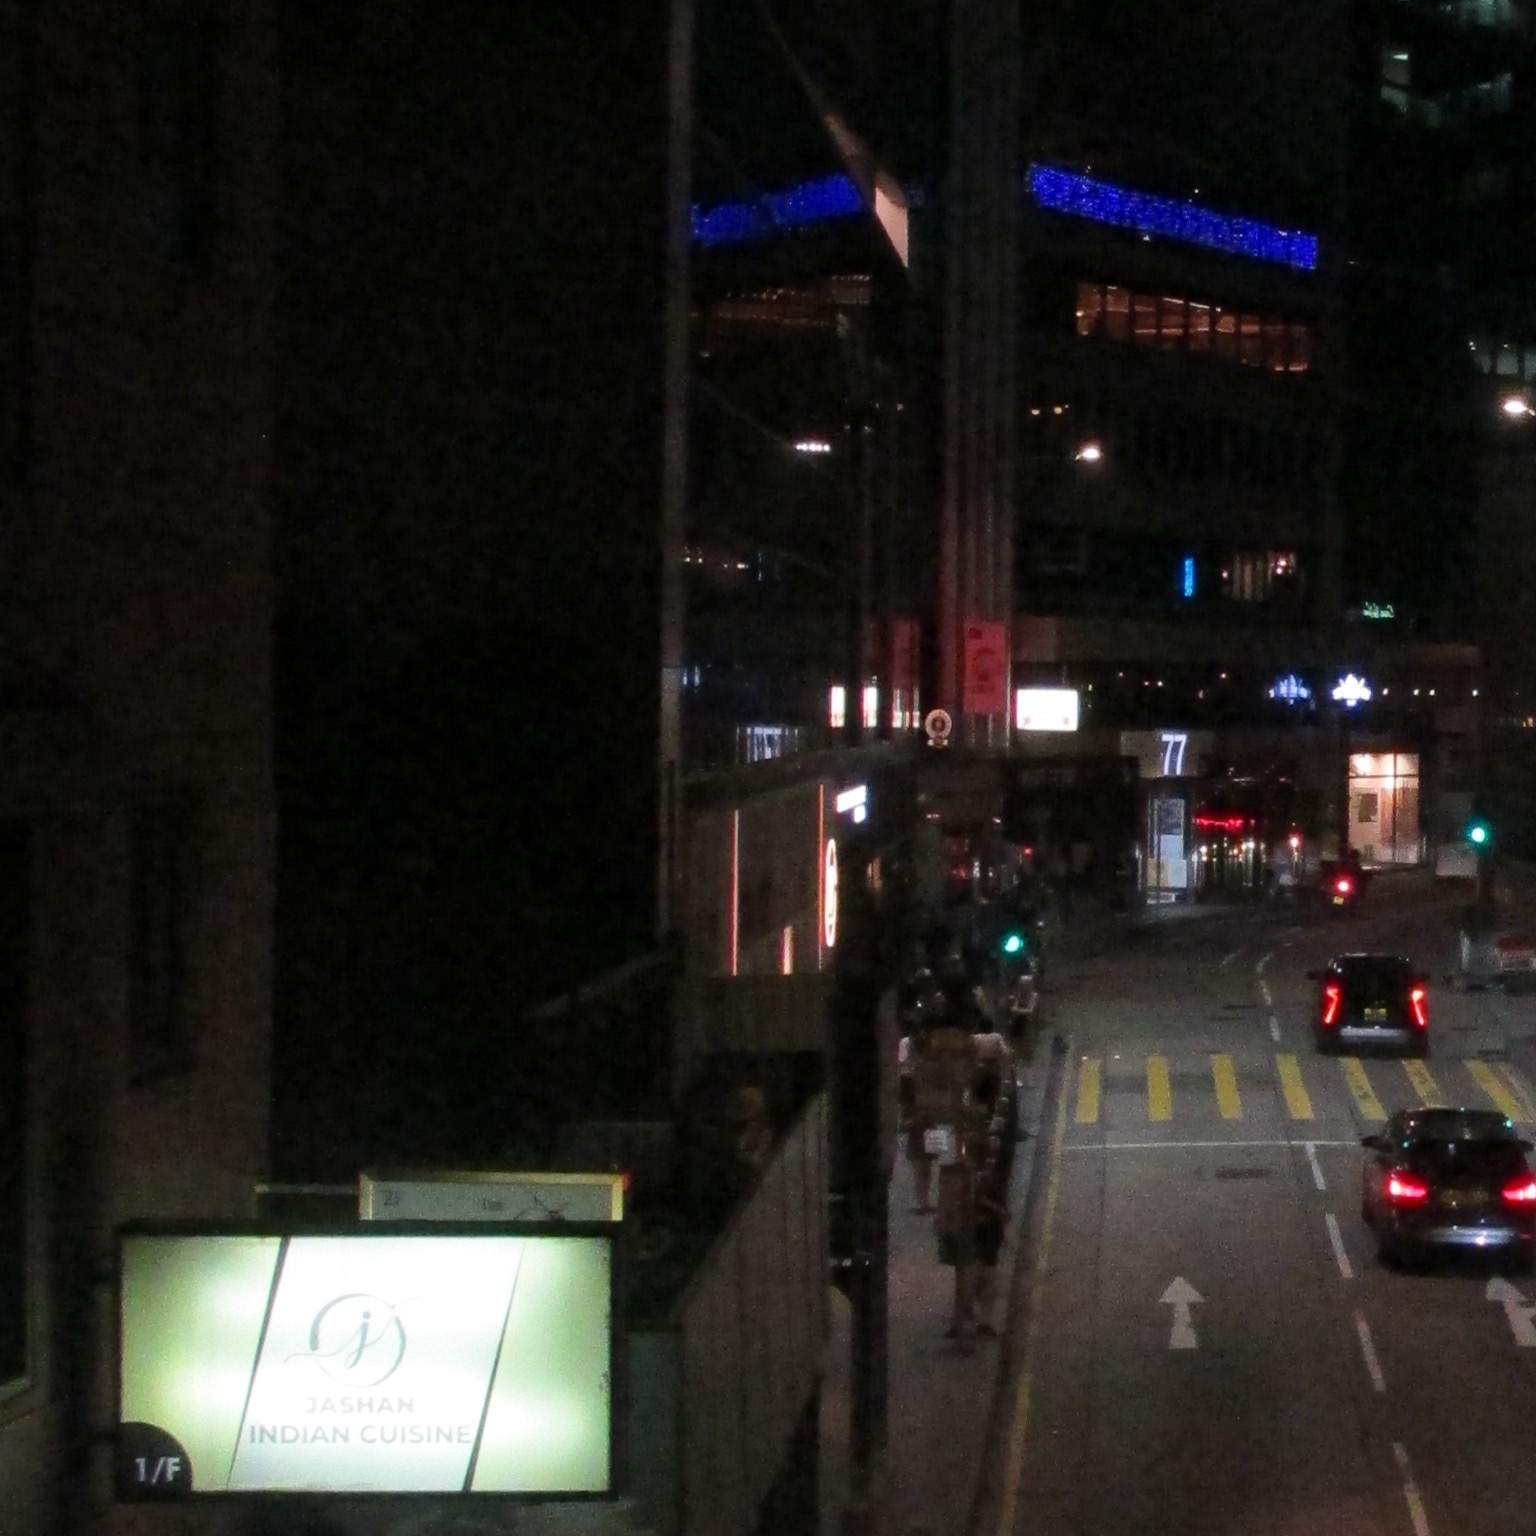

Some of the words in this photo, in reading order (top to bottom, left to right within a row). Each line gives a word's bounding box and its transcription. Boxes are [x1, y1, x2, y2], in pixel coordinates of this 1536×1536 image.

[1161, 734, 1187, 775] 77
[305, 1396, 415, 1414] JASHAN
[249, 1424, 350, 1445] INDIAN
[359, 1424, 473, 1445] CUISINE
[134, 1456, 181, 1485] 1/F
